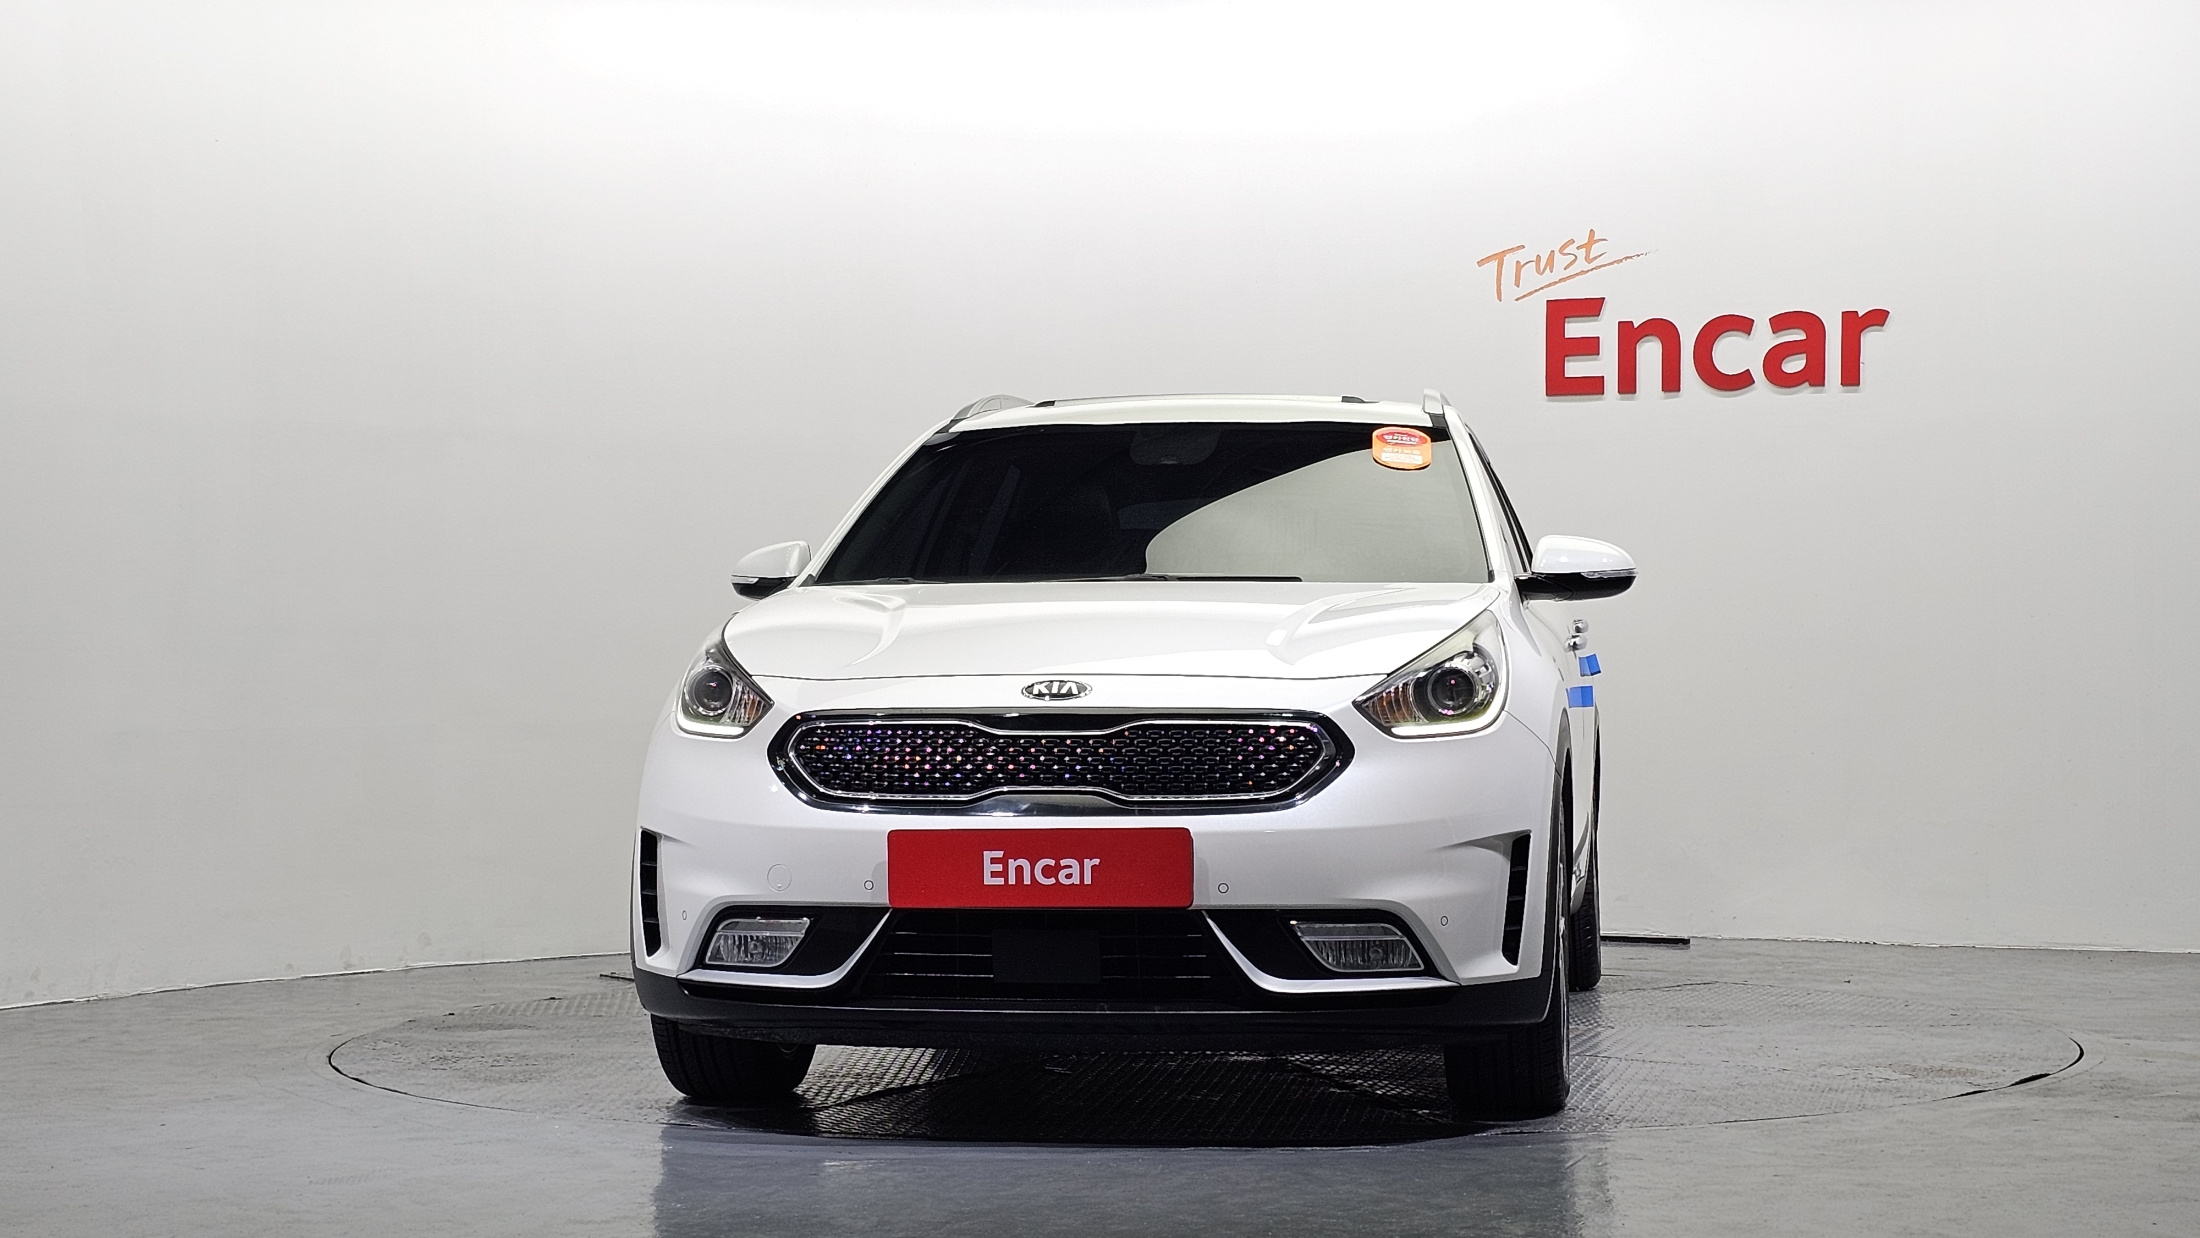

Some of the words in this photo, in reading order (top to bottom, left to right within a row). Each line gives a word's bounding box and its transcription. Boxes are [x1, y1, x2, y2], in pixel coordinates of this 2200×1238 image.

[1477, 229, 1608, 302] Trust
[1545, 297, 1890, 396] Encar
[1032, 681, 1079, 695] KIA
[983, 850, 1100, 885] Encar
